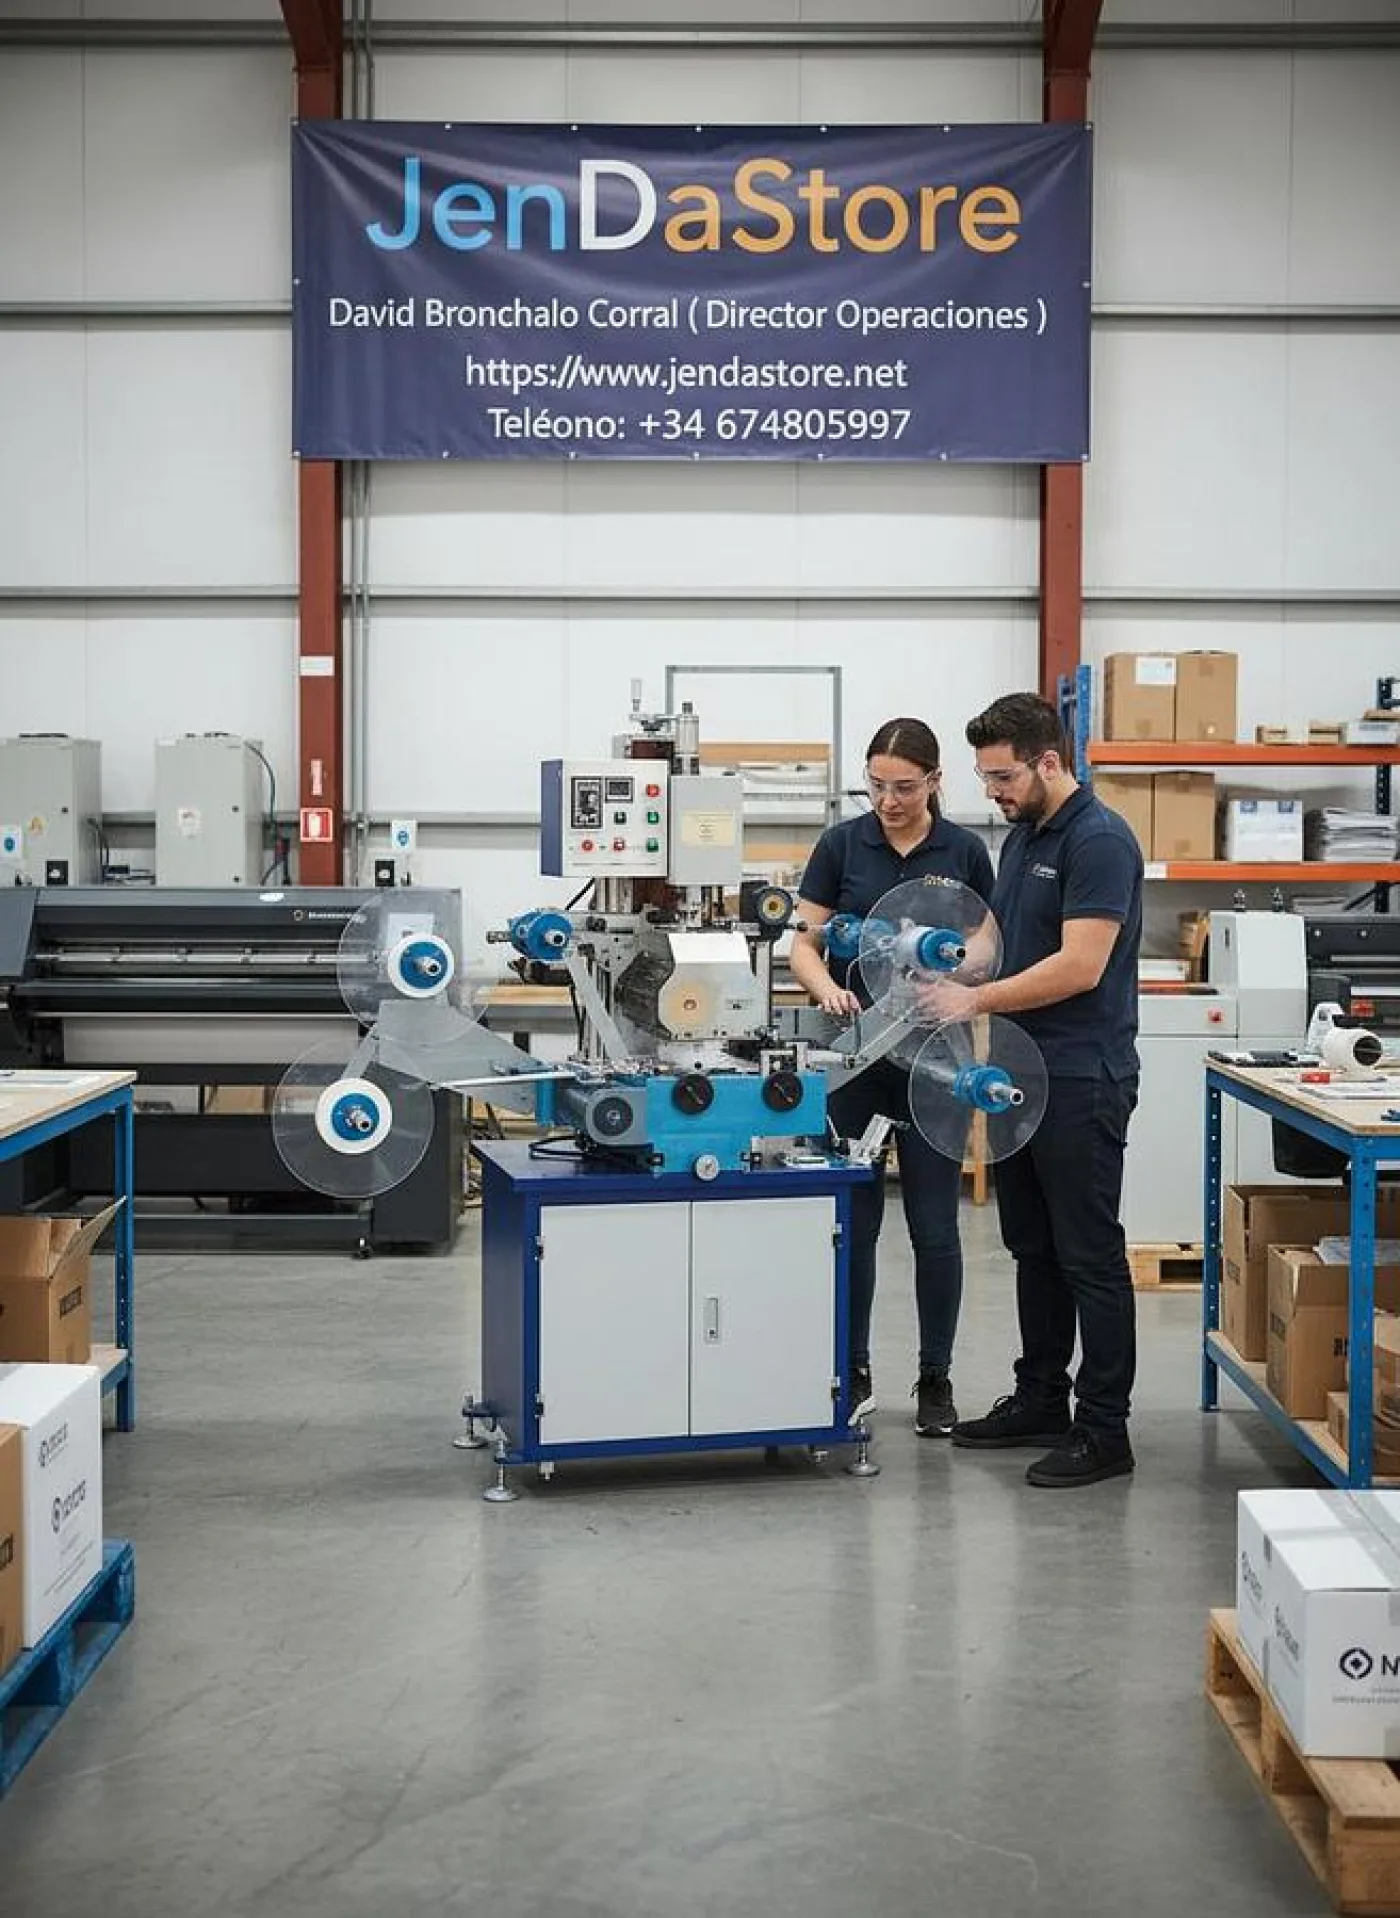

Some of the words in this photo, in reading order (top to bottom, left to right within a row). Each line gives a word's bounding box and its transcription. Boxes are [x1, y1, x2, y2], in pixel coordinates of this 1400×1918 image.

[366, 157, 1021, 253] JenDaStore
[329, 297, 414, 328] David
[425, 297, 579, 328] Bronchalo
[587, 297, 678, 328] Corral
[706, 299, 828, 329] Director
[836, 299, 1028, 336] Operaciones
[465, 355, 908, 394] https://www.jendastore.net
[488, 406, 625, 440] Teléono:
[638, 408, 706, 440] +34
[717, 408, 911, 440] 674805997
